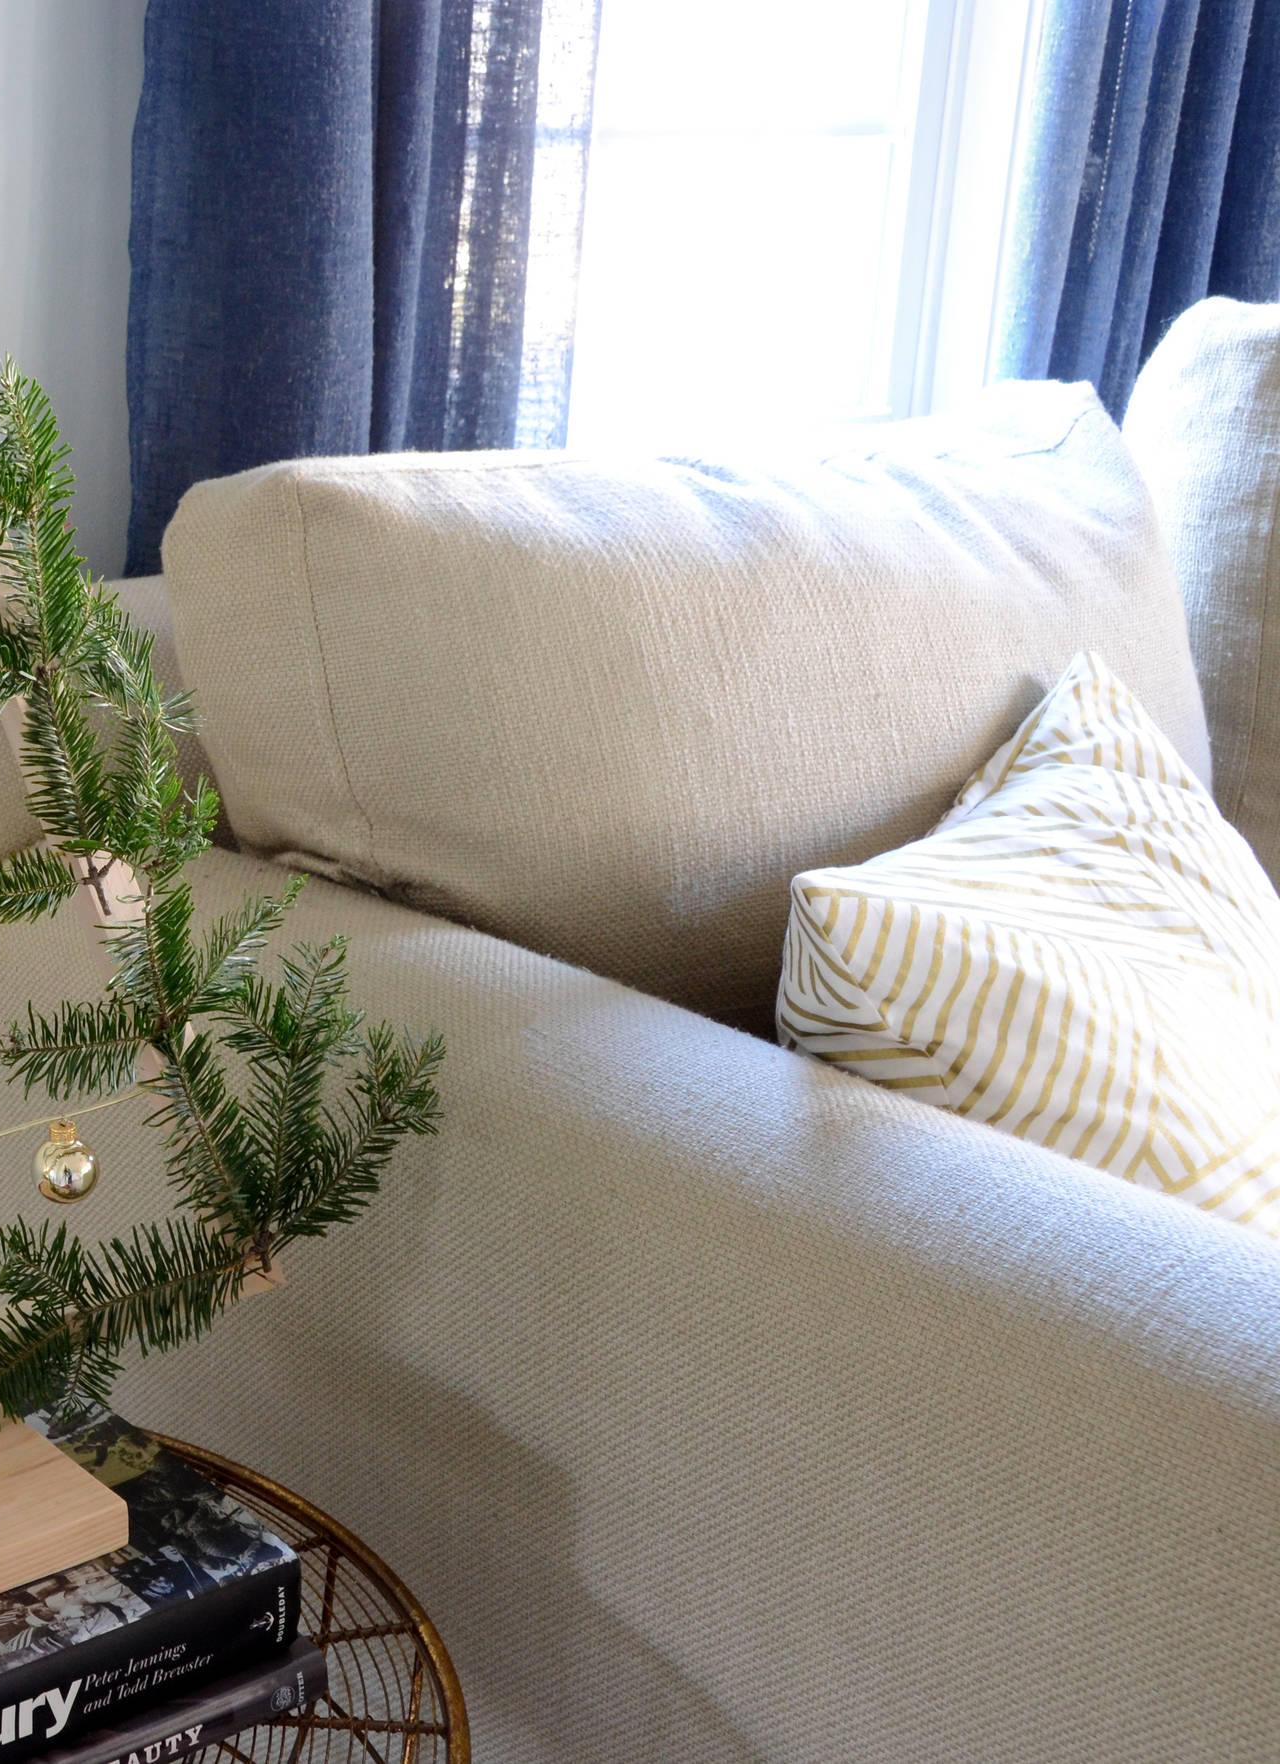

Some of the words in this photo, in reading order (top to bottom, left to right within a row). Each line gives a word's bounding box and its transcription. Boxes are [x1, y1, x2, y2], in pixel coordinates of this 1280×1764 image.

[276, 1586, 286, 1643] DOUBLEDAY
[83, 1689, 112, 1714] and
[117, 1674, 149, 1700] Todd
[152, 1653, 214, 1686] Brewster
[84, 1668, 122, 1692] Peter
[124, 1642, 187, 1677] Jennings
[296, 1671, 305, 1705] OTTER
[106, 1724, 203, 1764] AUTY
